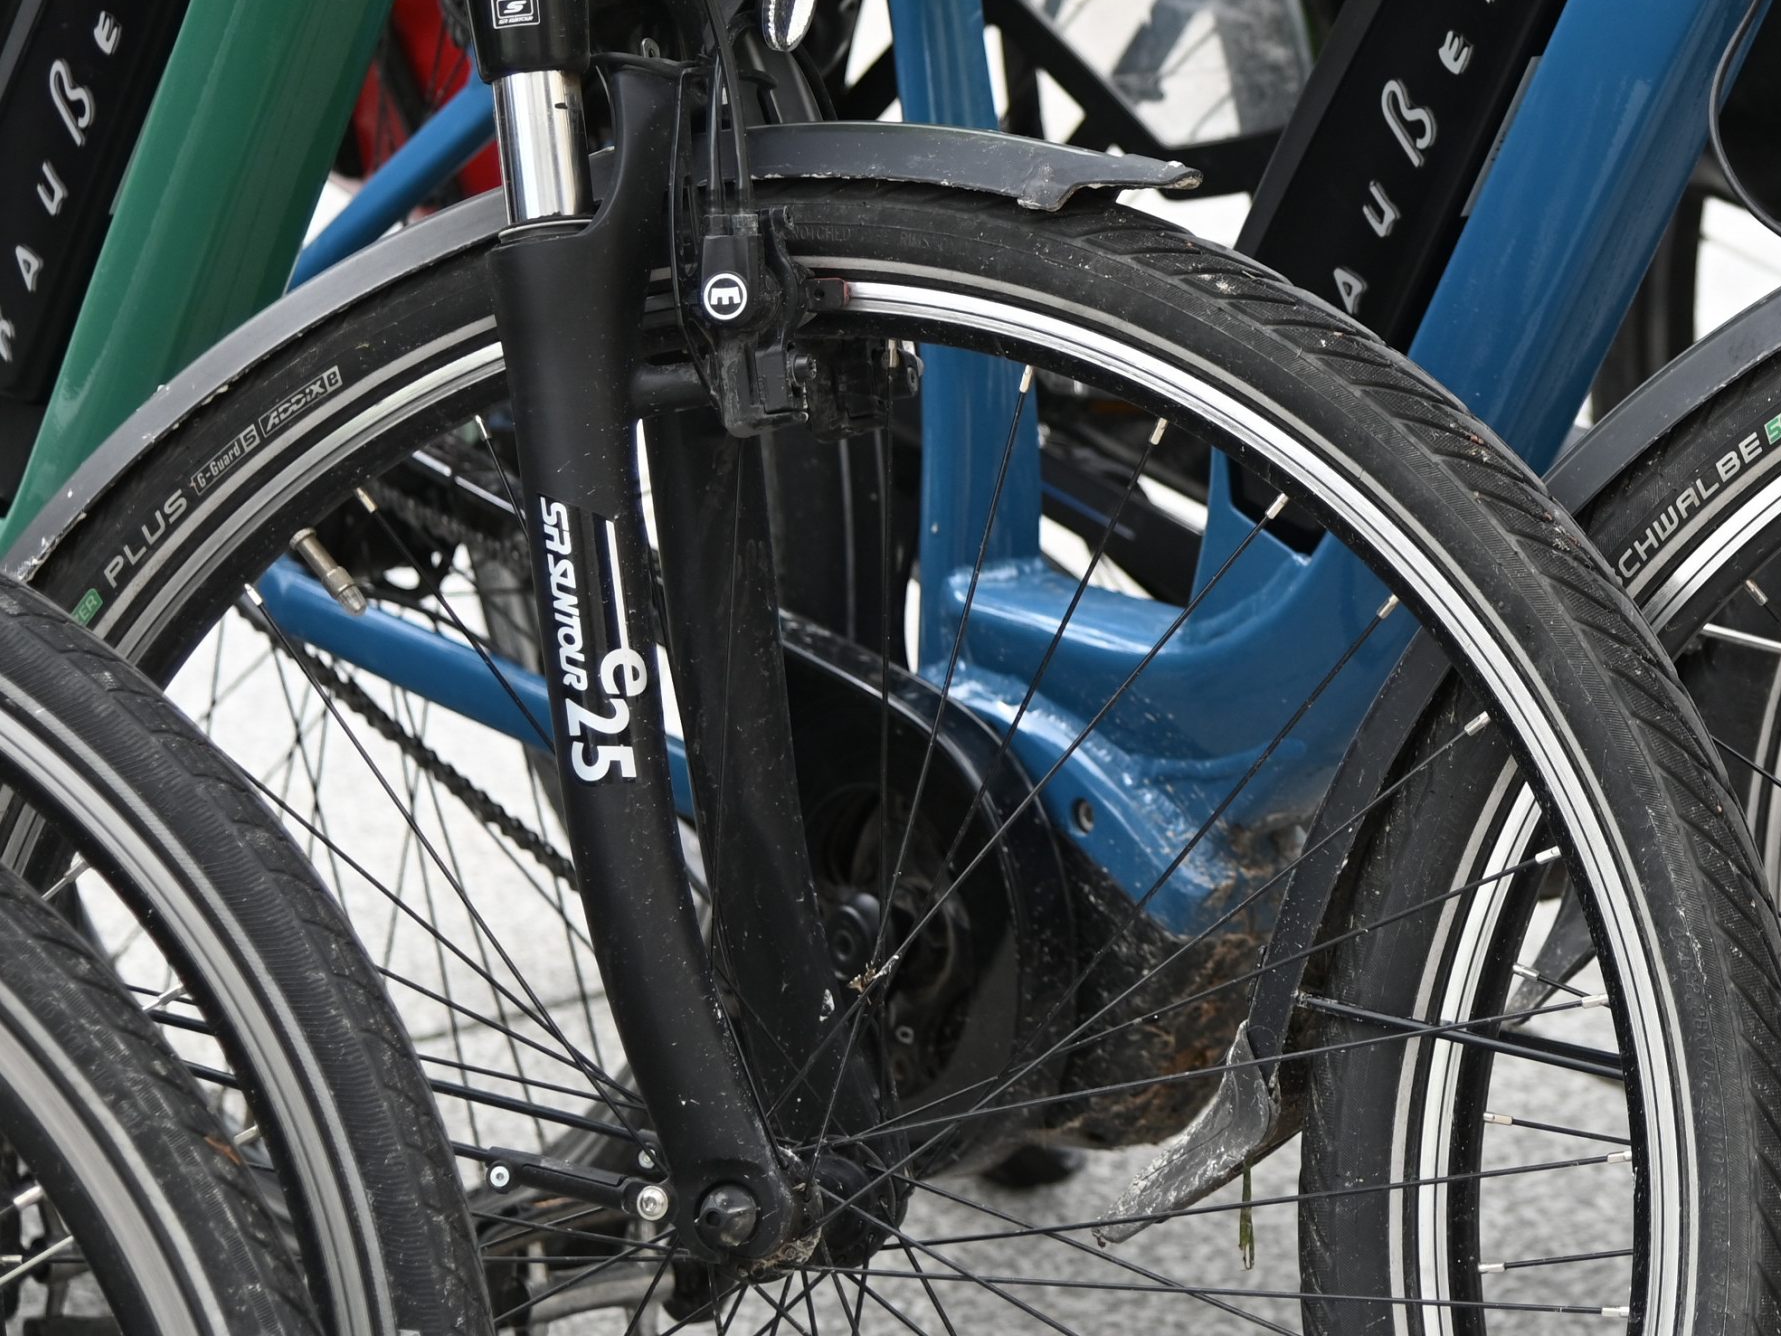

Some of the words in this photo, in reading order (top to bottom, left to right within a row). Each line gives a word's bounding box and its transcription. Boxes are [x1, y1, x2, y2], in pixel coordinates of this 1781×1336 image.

[103, 488, 189, 589] PLUS
[196, 441, 242, 490] G-Guard
[540, 496, 572, 557] SR
[1616, 432, 1763, 578] CHWALBE
[546, 552, 589, 693] SUNTOUR
